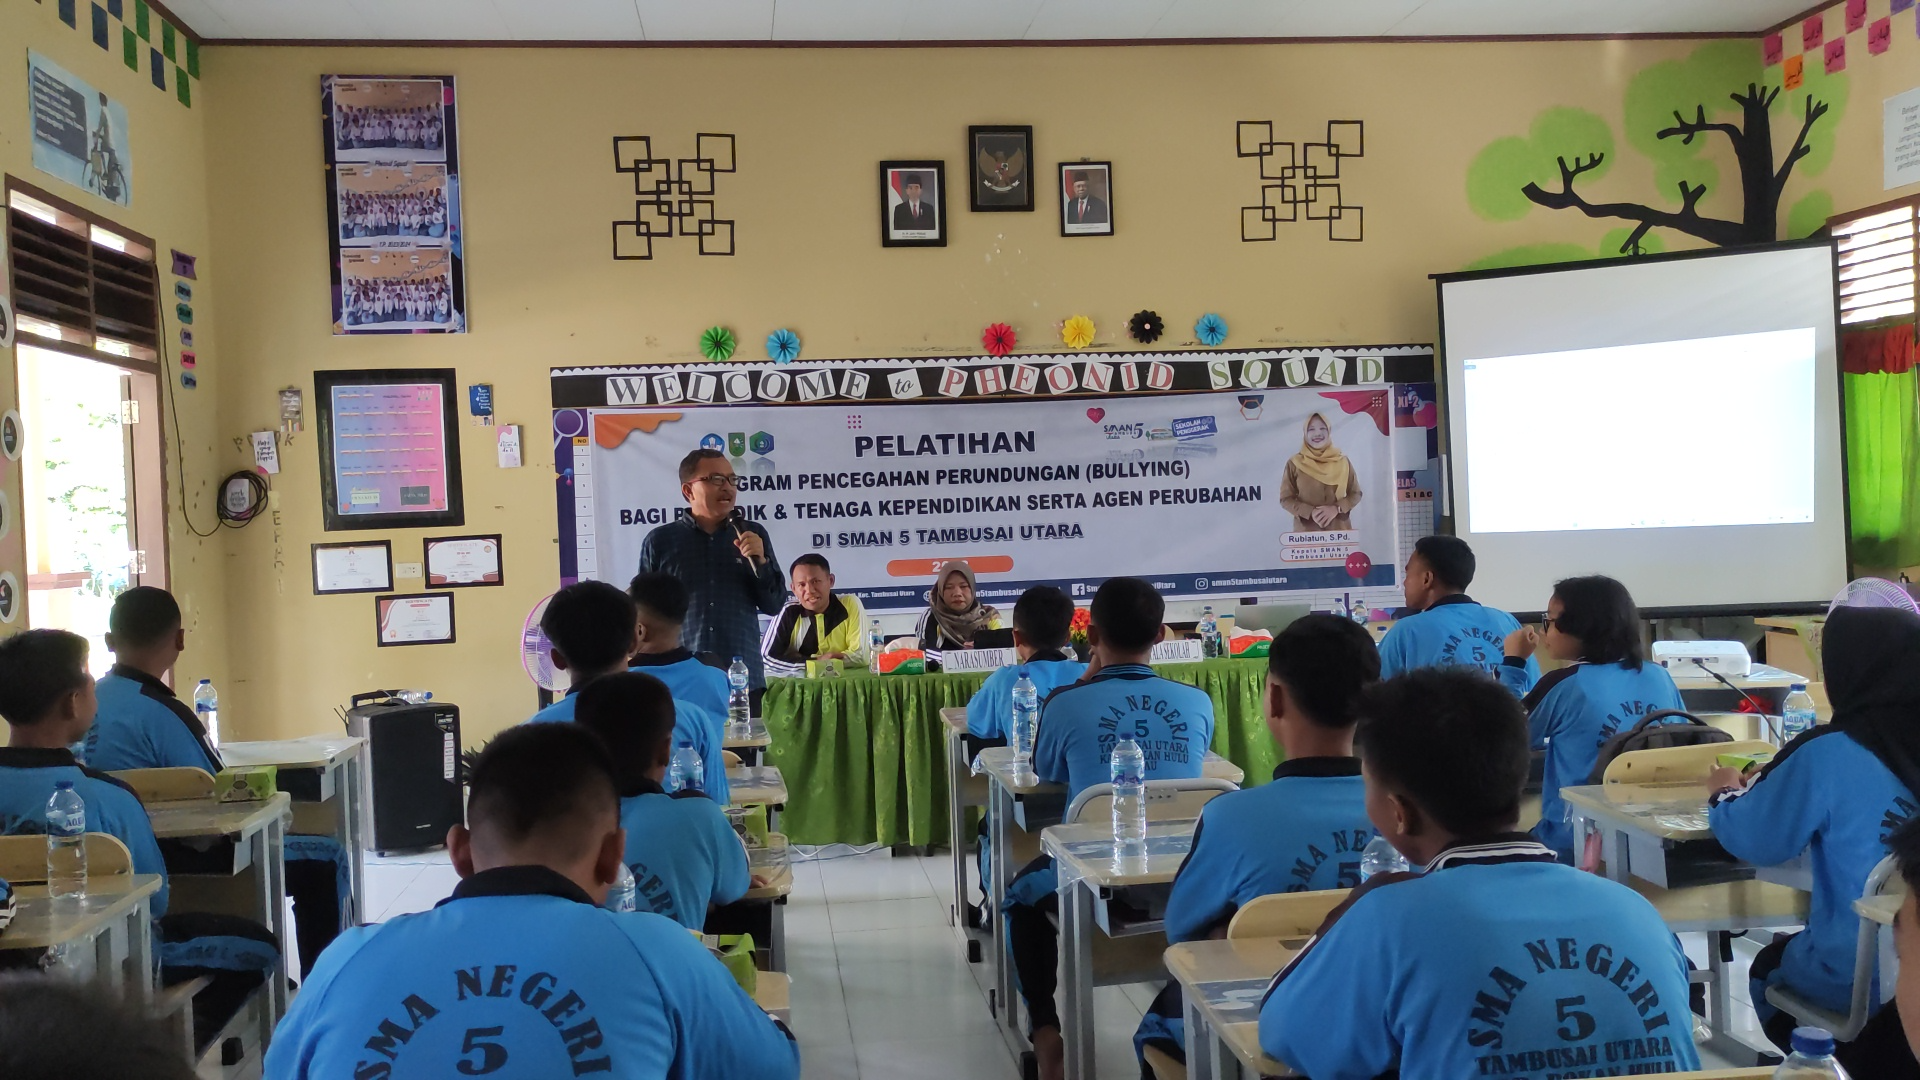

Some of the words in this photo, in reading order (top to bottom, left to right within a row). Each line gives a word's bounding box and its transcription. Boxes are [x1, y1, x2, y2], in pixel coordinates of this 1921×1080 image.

[607, 370, 869, 404] WELCOME
[894, 375, 915, 394] to
[943, 363, 1175, 396] PHEONID
[1210, 357, 1383, 389] SQUAD
[1132, 422, 1144, 439] 5
[1175, 420, 1201, 430] SEKOLAH
[1176, 424, 1209, 436] PENGGERAK
[855, 430, 1036, 458] PELATIHAN
[737, 474, 792, 492] GRAM
[797, 470, 930, 489] PENCEGAHAN
[935, 464, 1080, 486] PERUNDUNGAN
[1086, 460, 1190, 484] (BULLYING)
[1397, 478, 1416, 488] ELAS
[620, 507, 668, 526] BAGI
[774, 504, 788, 520] &
[794, 501, 872, 520] TENAGA
[878, 495, 1021, 518] KEPENDIDIKAN
[1028, 492, 1089, 512] SERTA
[1093, 489, 1144, 508] AGEN
[1149, 485, 1262, 506] PERUBAHAN
[811, 532, 831, 548] DI
[837, 530, 894, 548] SMAN
[899, 529, 911, 545] 5
[916, 524, 1014, 545] TAMBUSAI
[1020, 523, 1084, 542] UTARA
[1288, 535, 1328, 543] Rubiatun,
[1329, 533, 1351, 541] S.Pd.
[952, 650, 1004, 669] NARASUMBER
[1164, 641, 1191, 660] SEKOLAH
[1442, 634, 1462, 664] SMA
[1472, 646, 1486, 662] 5
[1098, 705, 1126, 743] SMA
[1126, 695, 1189, 743] NEGERI
[1134, 719, 1150, 738] 5
[1155, 740, 1189, 754] UTARA
[1164, 753, 1189, 764] HULU
[1336, 861, 1362, 889] 5
[1467, 966, 1528, 1050] SMA
[1523, 937, 1670, 1034] NEGERI
[354, 993, 441, 1080] SMA
[454, 964, 613, 1078] NEGERI
[1556, 995, 1597, 1041] 5
[456, 1025, 509, 1076] 5
[1475, 1044, 1599, 1076] TAMBUSAI
[1604, 1036, 1674, 1063] UTARA
